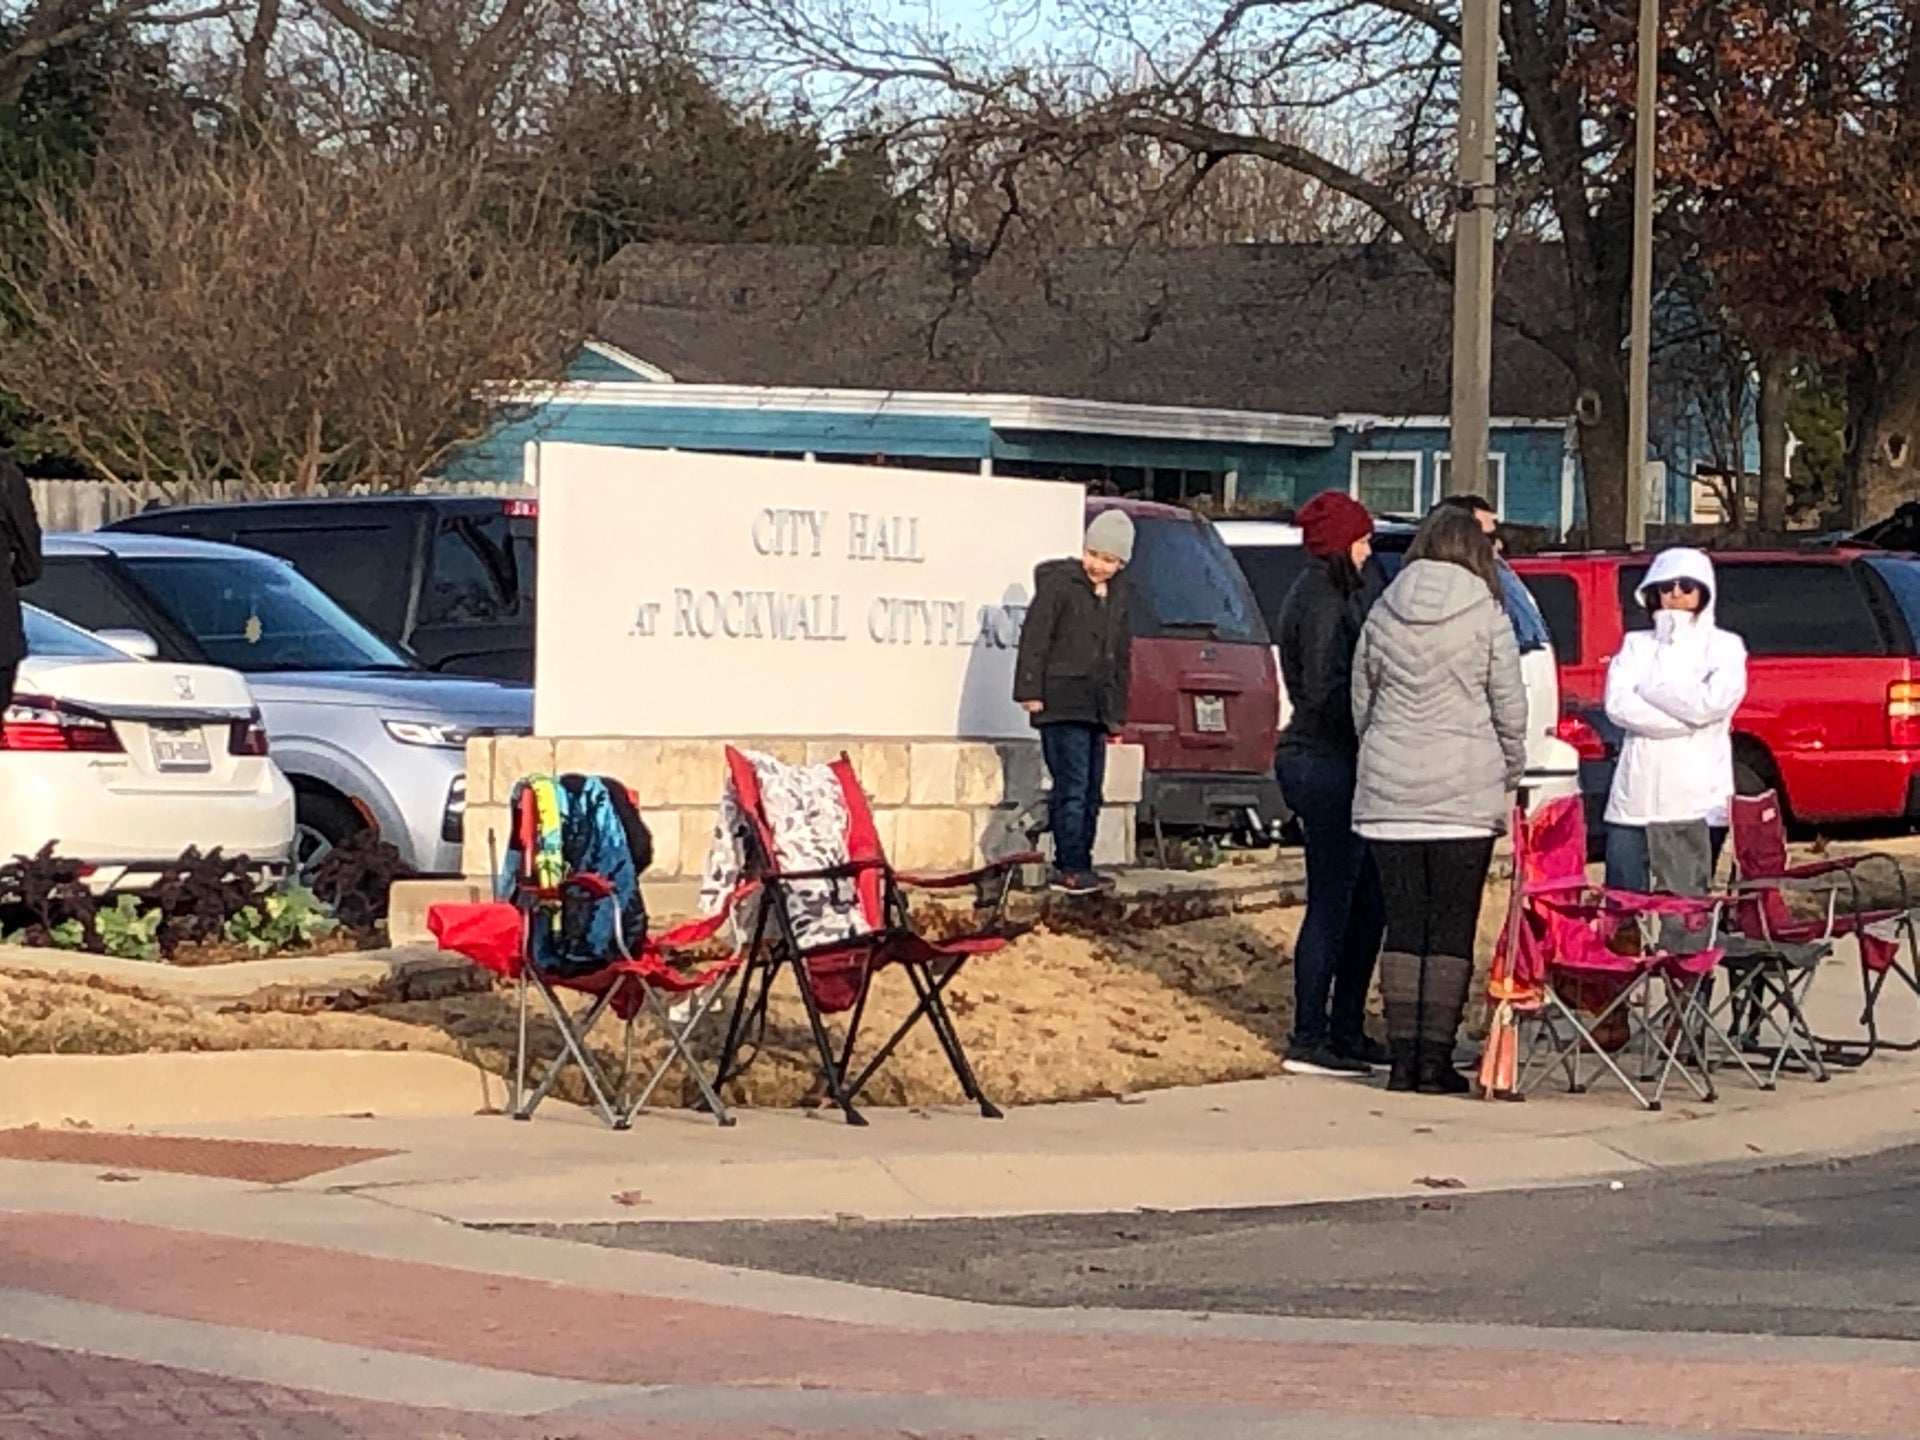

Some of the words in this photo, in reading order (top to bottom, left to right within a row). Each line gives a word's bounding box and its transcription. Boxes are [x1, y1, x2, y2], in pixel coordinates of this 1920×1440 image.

[751, 508, 829, 557] CITY
[847, 512, 925, 563] HALL
[628, 602, 661, 637] AT
[673, 587, 848, 641] ROCKWALL
